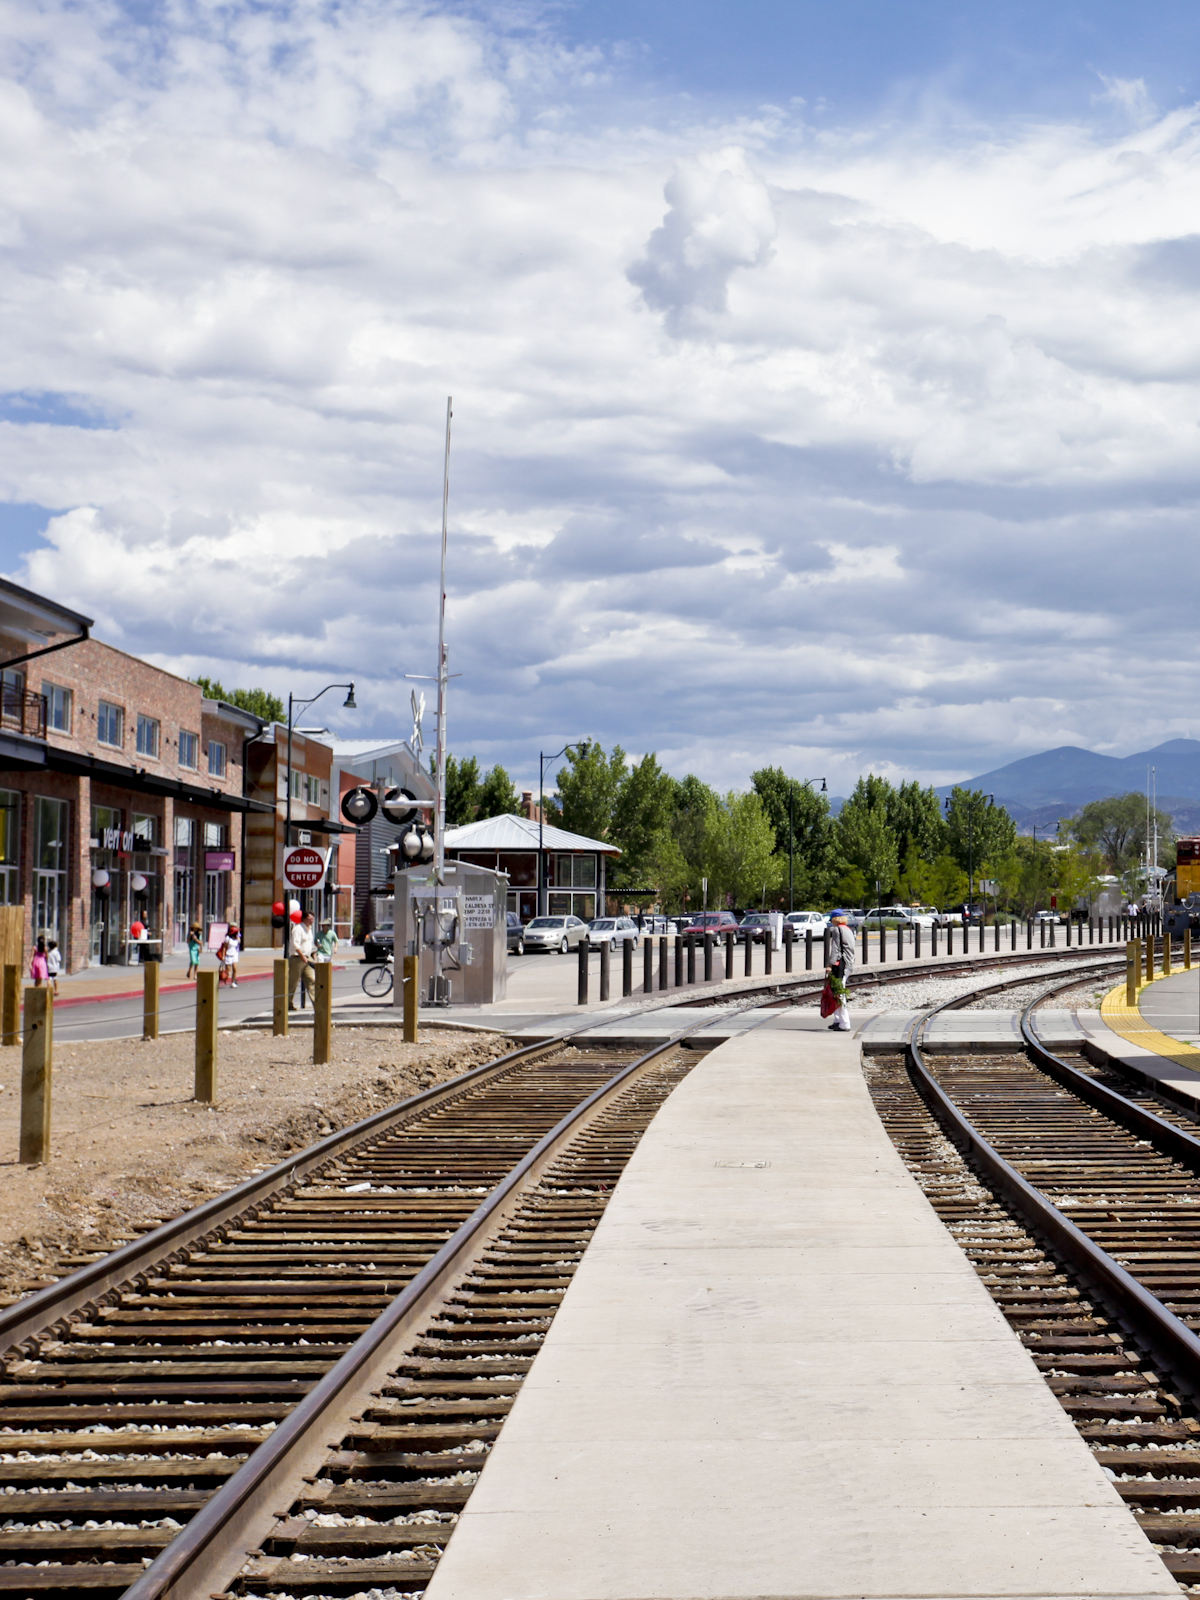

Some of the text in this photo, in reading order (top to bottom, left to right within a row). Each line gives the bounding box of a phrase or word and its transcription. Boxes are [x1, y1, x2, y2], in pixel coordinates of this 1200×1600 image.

[103, 824, 134, 857] verizon
[290, 855, 319, 863] DO NOT
[290, 873, 317, 881] ENTER
